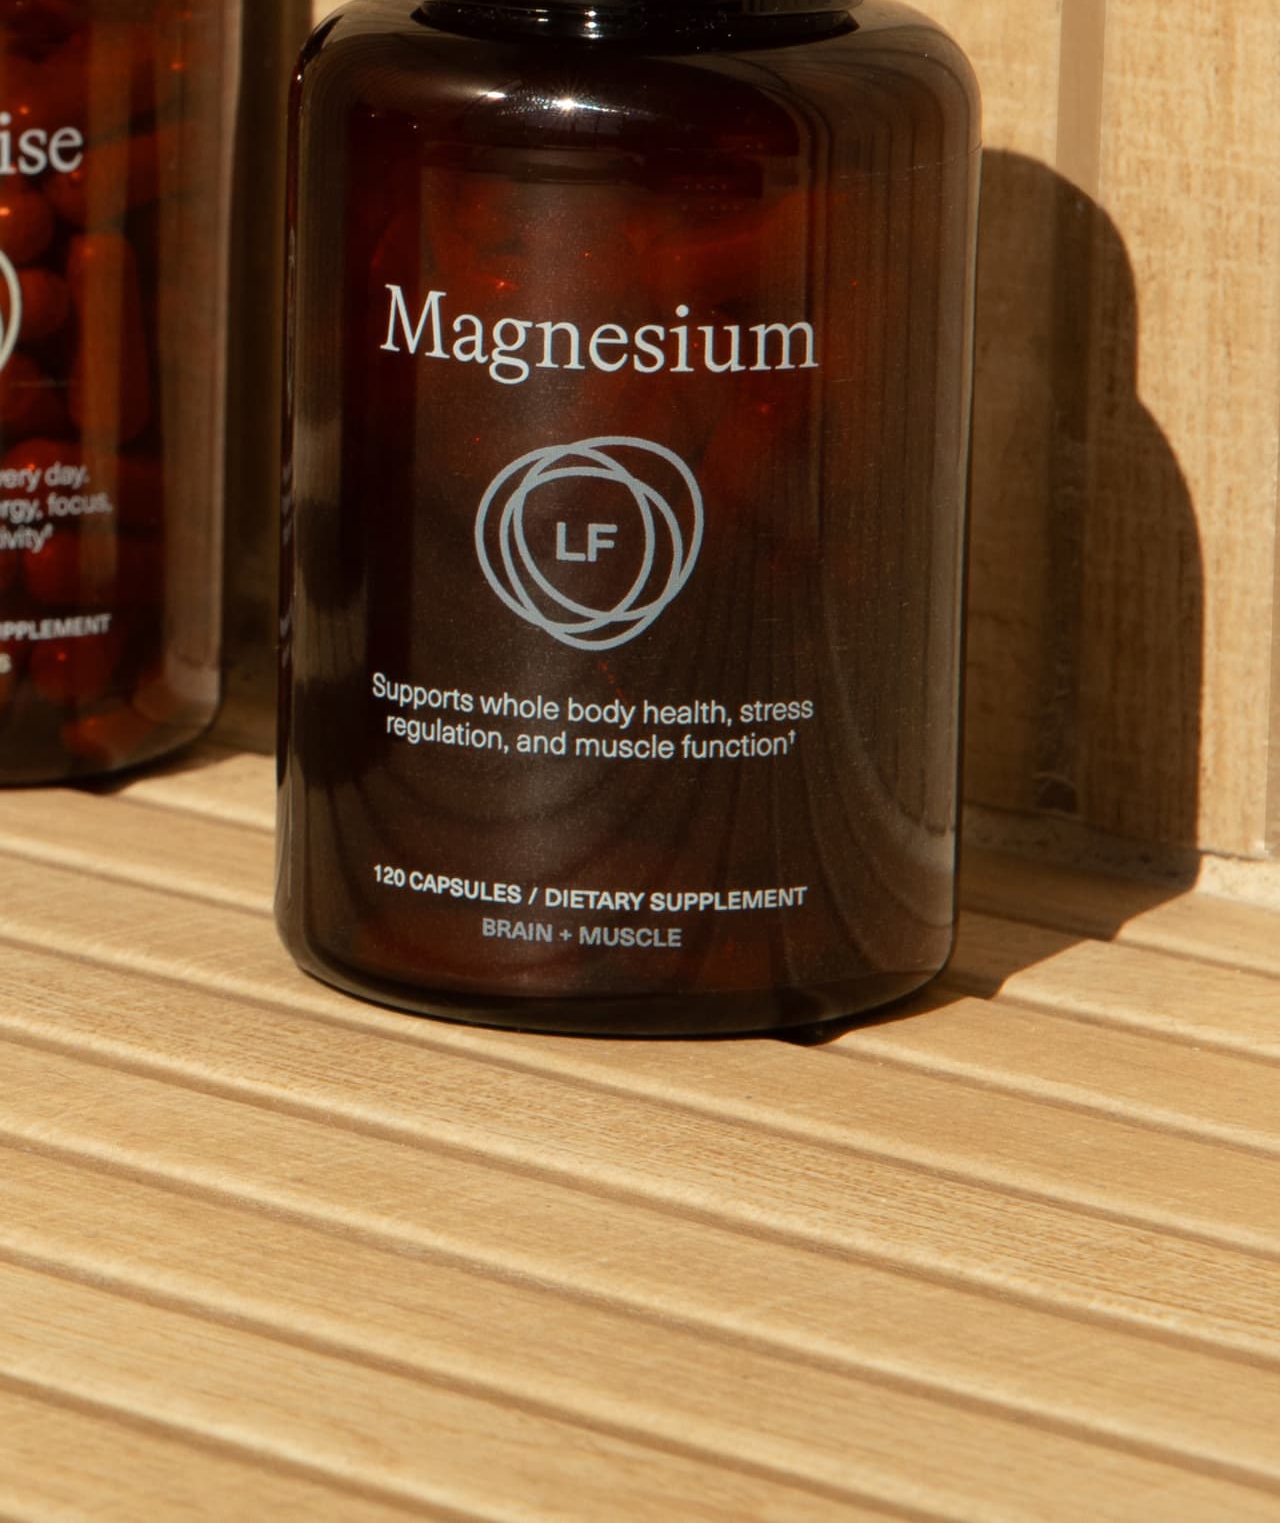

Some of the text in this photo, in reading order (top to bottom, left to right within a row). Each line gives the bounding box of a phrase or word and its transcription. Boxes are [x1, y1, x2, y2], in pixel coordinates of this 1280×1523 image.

[380, 284, 820, 385] Magnesium
[555, 521, 618, 562] LF
[371, 673, 814, 728] Supports whole body health, stress
[386, 714, 510, 755] regulation,
[516, 730, 567, 756] and
[574, 733, 675, 760] muscle
[372, 864, 406, 888] 120
[409, 871, 522, 904] CAPSULES
[545, 888, 646, 911] DIETARY
[649, 886, 808, 912] SUPPLEMENT
[482, 917, 554, 943] BRAIN
[579, 925, 682, 948] MUSCLE
